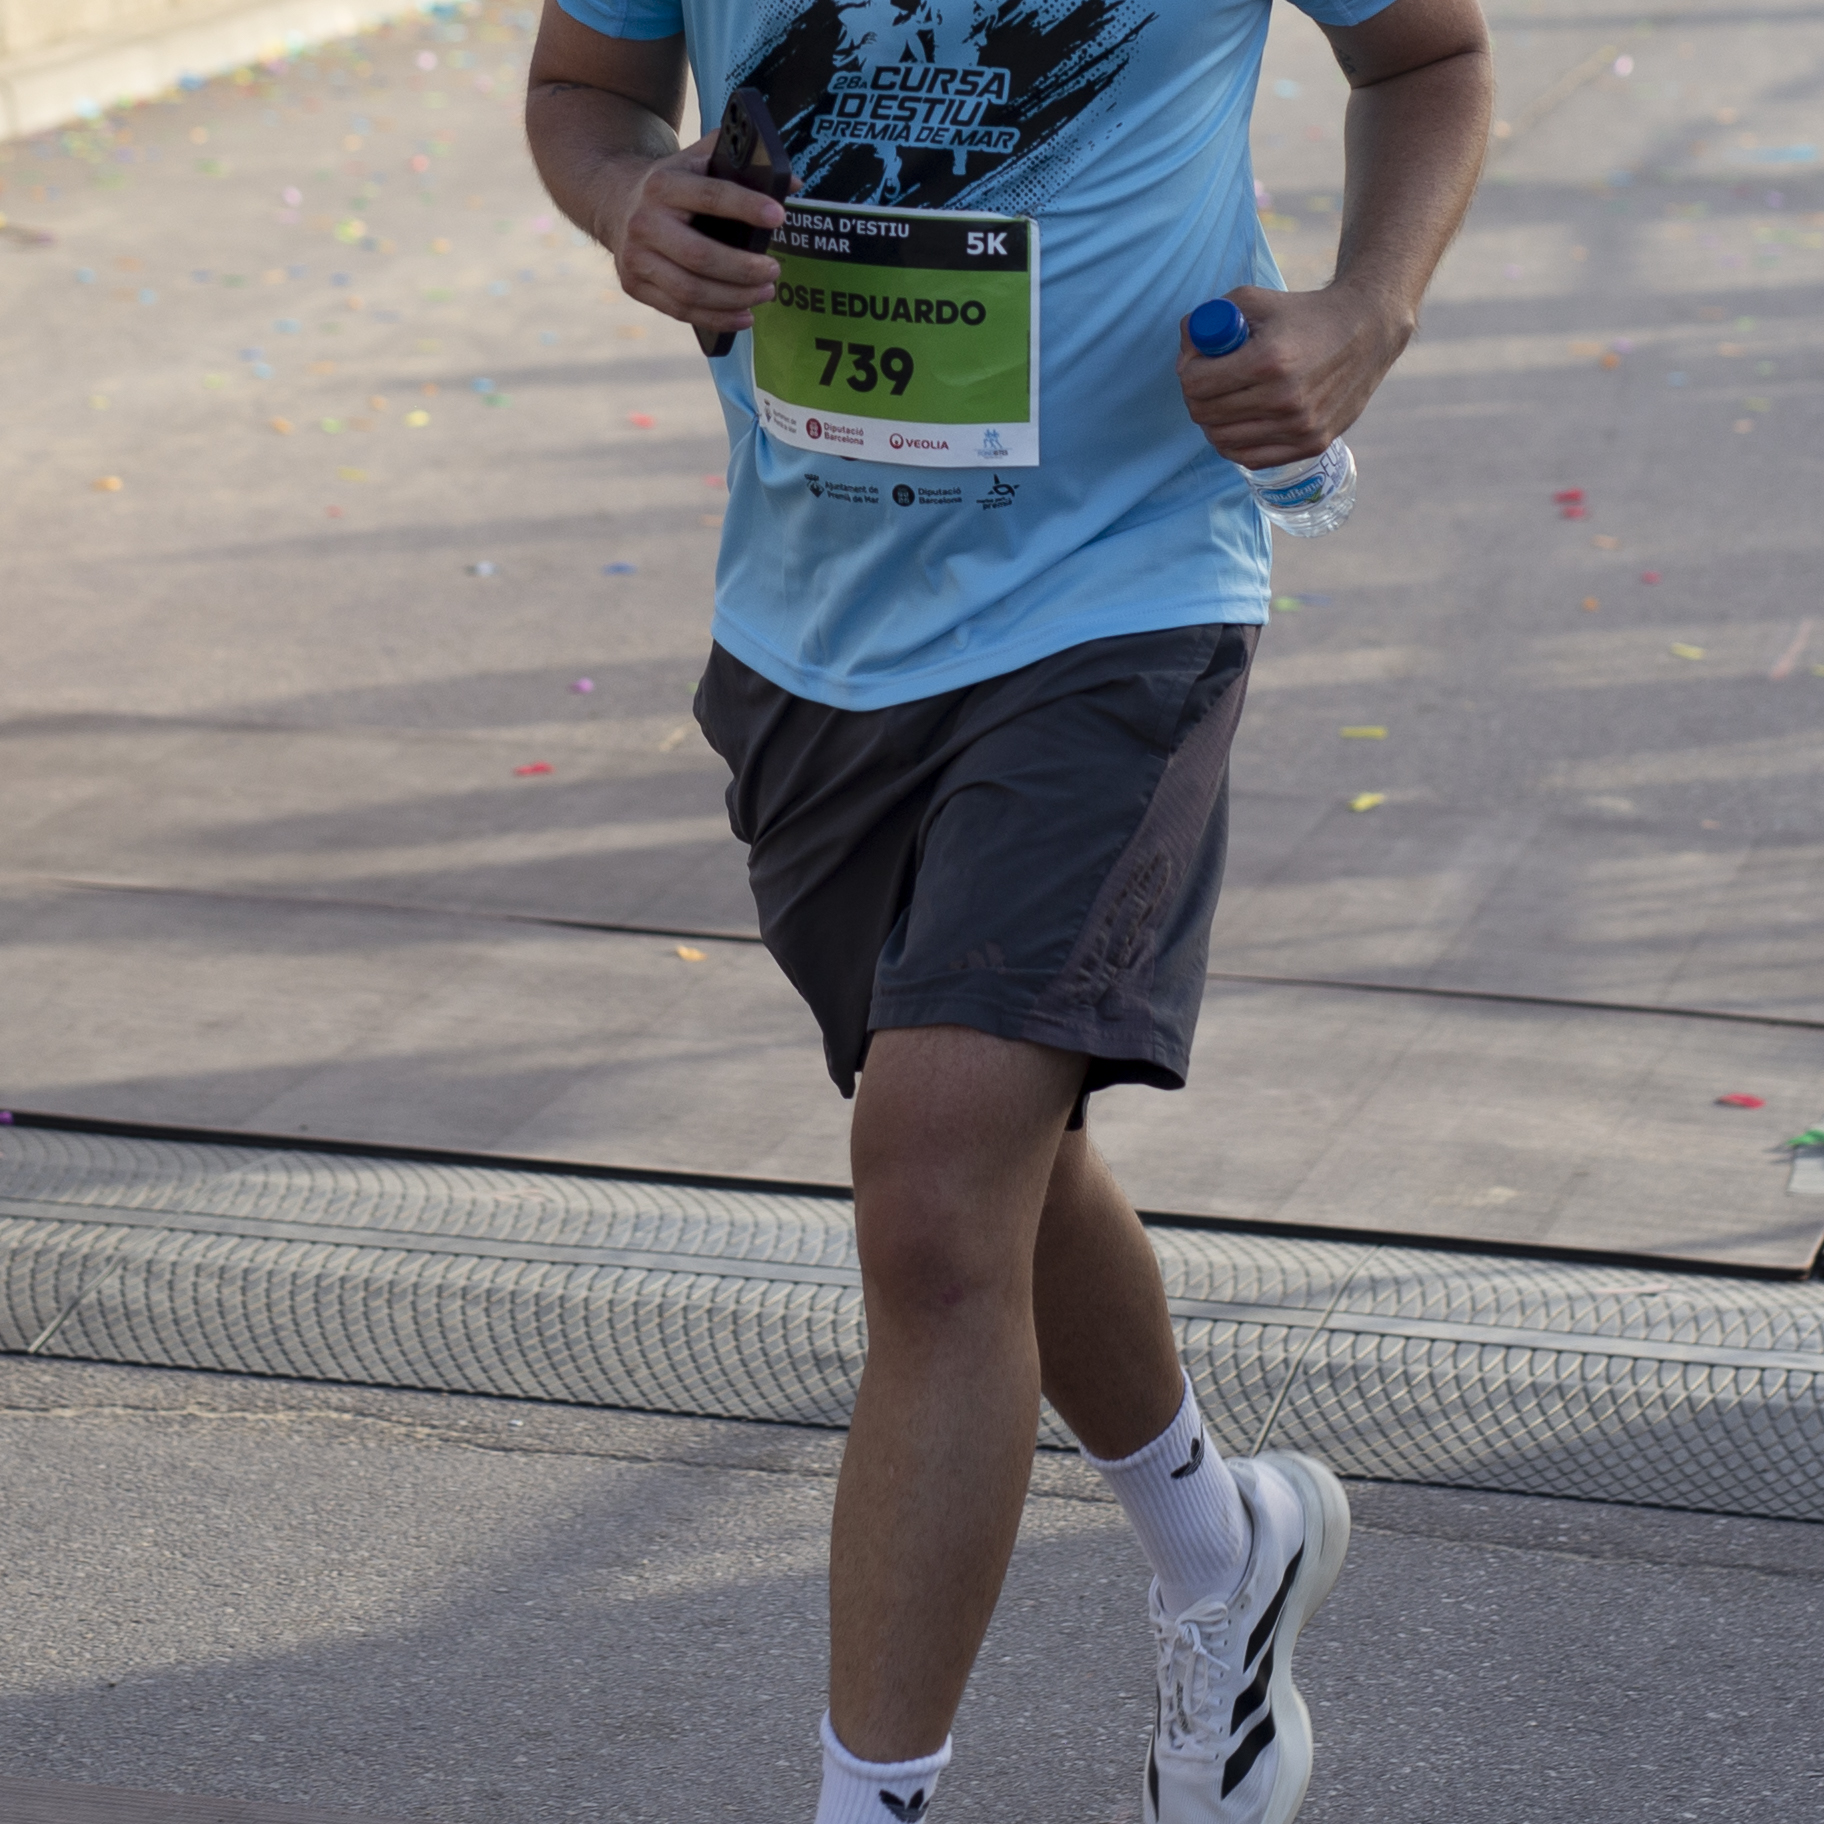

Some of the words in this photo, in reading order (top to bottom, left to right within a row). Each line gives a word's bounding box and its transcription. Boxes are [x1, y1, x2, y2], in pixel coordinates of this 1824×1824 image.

[869, 65, 1007, 101] CURSA
[835, 93, 985, 127] D'ESTIU
[814, 118, 912, 142] PREMIÀ
[913, 127, 951, 145] DE
[948, 128, 1016, 150] MAR
[783, 210, 834, 232] CURSA
[790, 232, 810, 249] DE
[814, 235, 851, 254] MAR
[966, 231, 1008, 256] 5K
[773, 280, 826, 315] OSE
[830, 290, 987, 326] EDUARDO
[814, 337, 915, 397] 739
[823, 422, 864, 436] Diputació
[824, 432, 864, 445] Barcelona
[905, 438, 950, 450] VEOLIA
